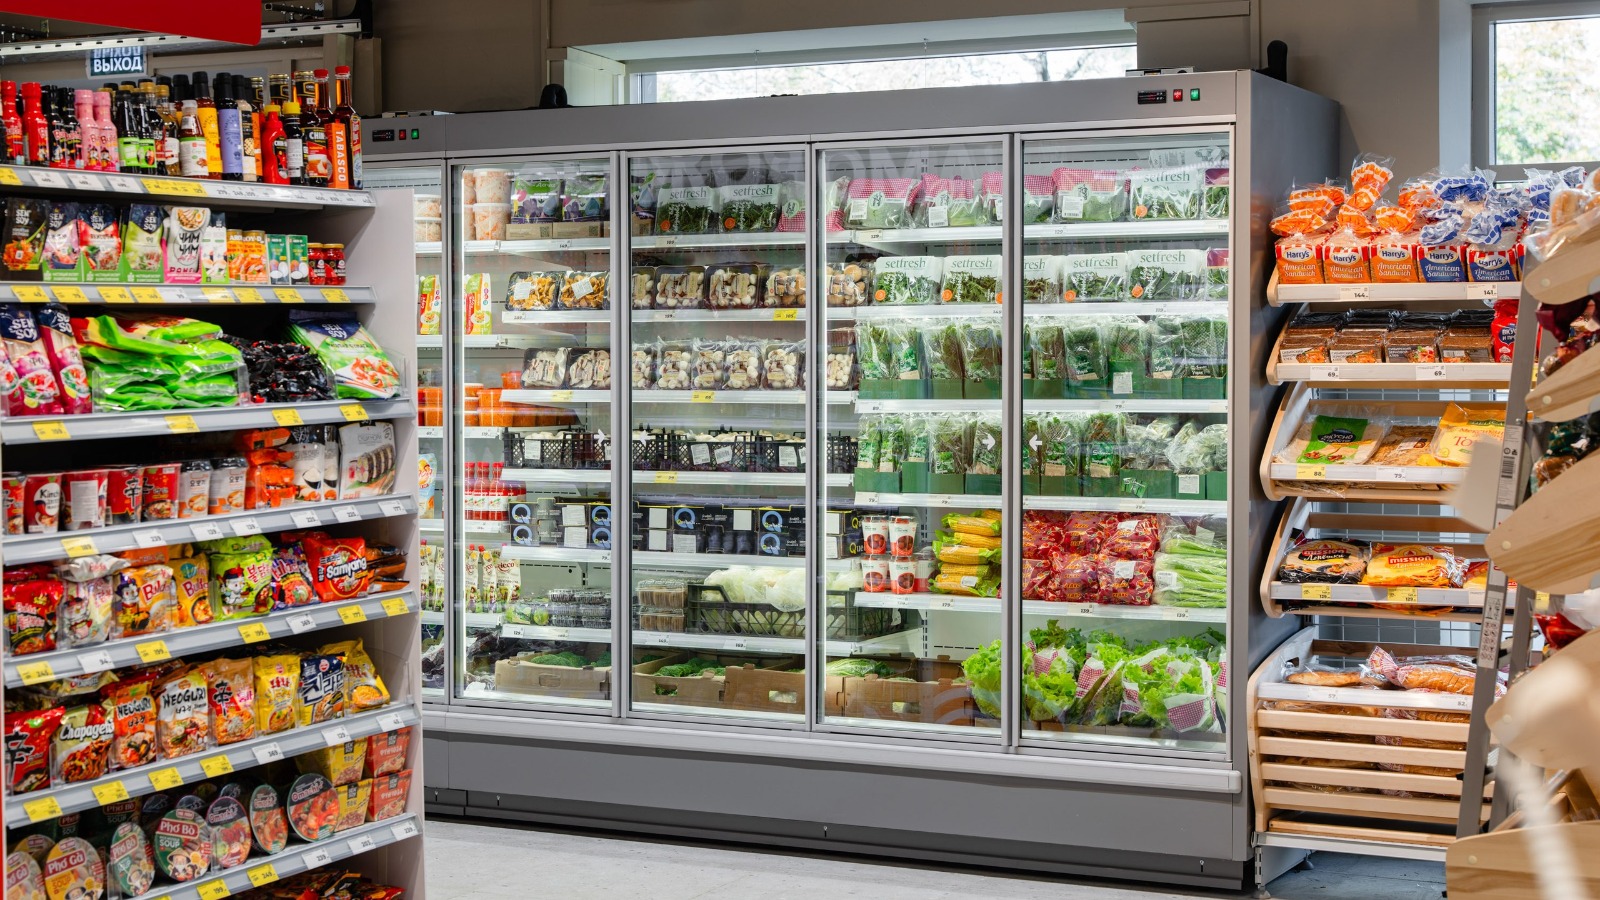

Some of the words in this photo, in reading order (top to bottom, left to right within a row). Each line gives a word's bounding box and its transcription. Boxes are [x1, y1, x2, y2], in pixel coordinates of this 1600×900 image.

[93, 56, 143, 73] ВЫХОД
[334, 129, 347, 183] TABASCO
[669, 187, 707, 201] setfresh
[734, 185, 773, 198] setfresh
[178, 232, 200, 243] ЧИМ
[178, 244, 200, 254] ЧИМ
[1380, 249, 1406, 261] Harry's
[1139, 250, 1187, 264] setfresh
[1286, 250, 1310, 262] Harry's
[1332, 253, 1357, 264] Harry's
[1429, 250, 1454, 262] Harry's
[884, 257, 926, 271] setfresh
[951, 257, 993, 269] setfresh
[1073, 256, 1119, 269] setfresh
[1282, 263, 1316, 272] American
[1377, 263, 1412, 272] American
[1424, 264, 1460, 273] American
[1284, 270, 1316, 278] Sandwich
[1330, 265, 1363, 274] American
[1331, 271, 1363, 280] Sandwich
[1378, 270, 1411, 278] Sandwich
[1426, 270, 1460, 278] Sandwich
[1389, 555, 1433, 564] mission
[326, 556, 368, 580] Samyang
[161, 687, 206, 709] NEOGURI
[116, 696, 152, 720] NEOGURI
[159, 839, 180, 849] SOUP
